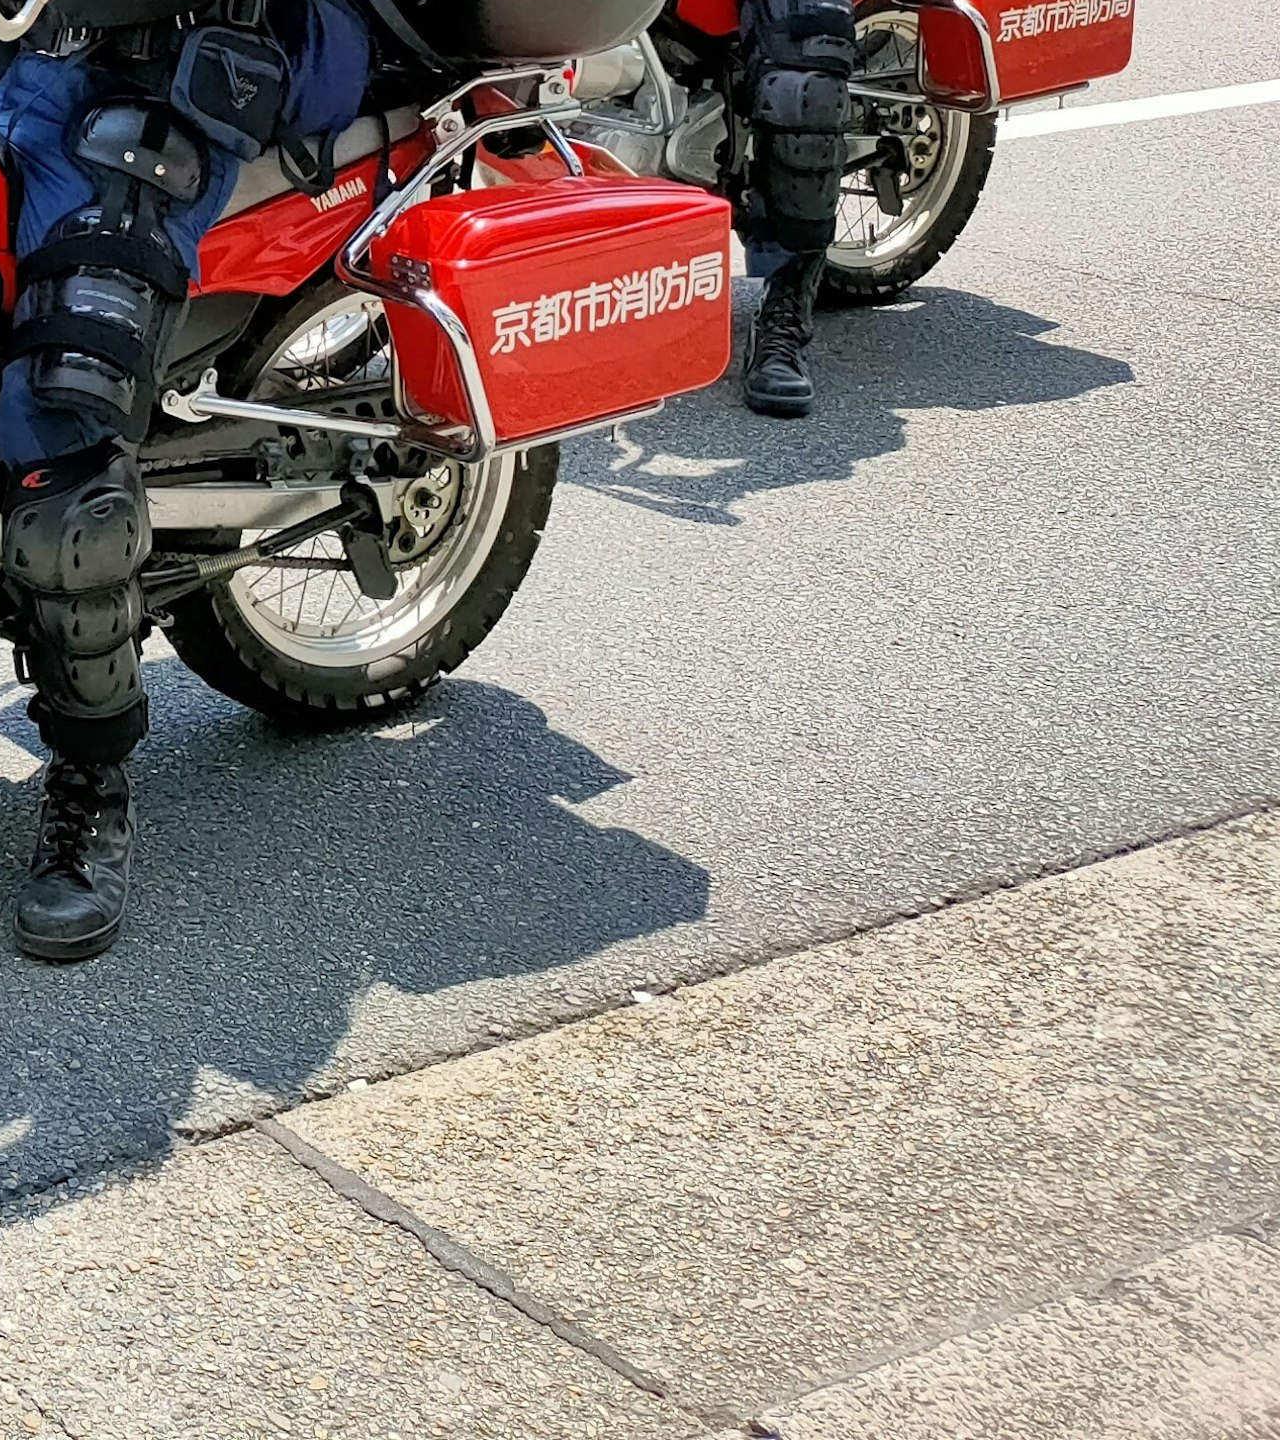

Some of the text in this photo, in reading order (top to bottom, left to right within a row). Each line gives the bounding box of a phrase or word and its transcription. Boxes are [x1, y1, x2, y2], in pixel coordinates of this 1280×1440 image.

[310, 176, 368, 213] YAMAHA
[490, 251, 724, 356] 京都市消防局
